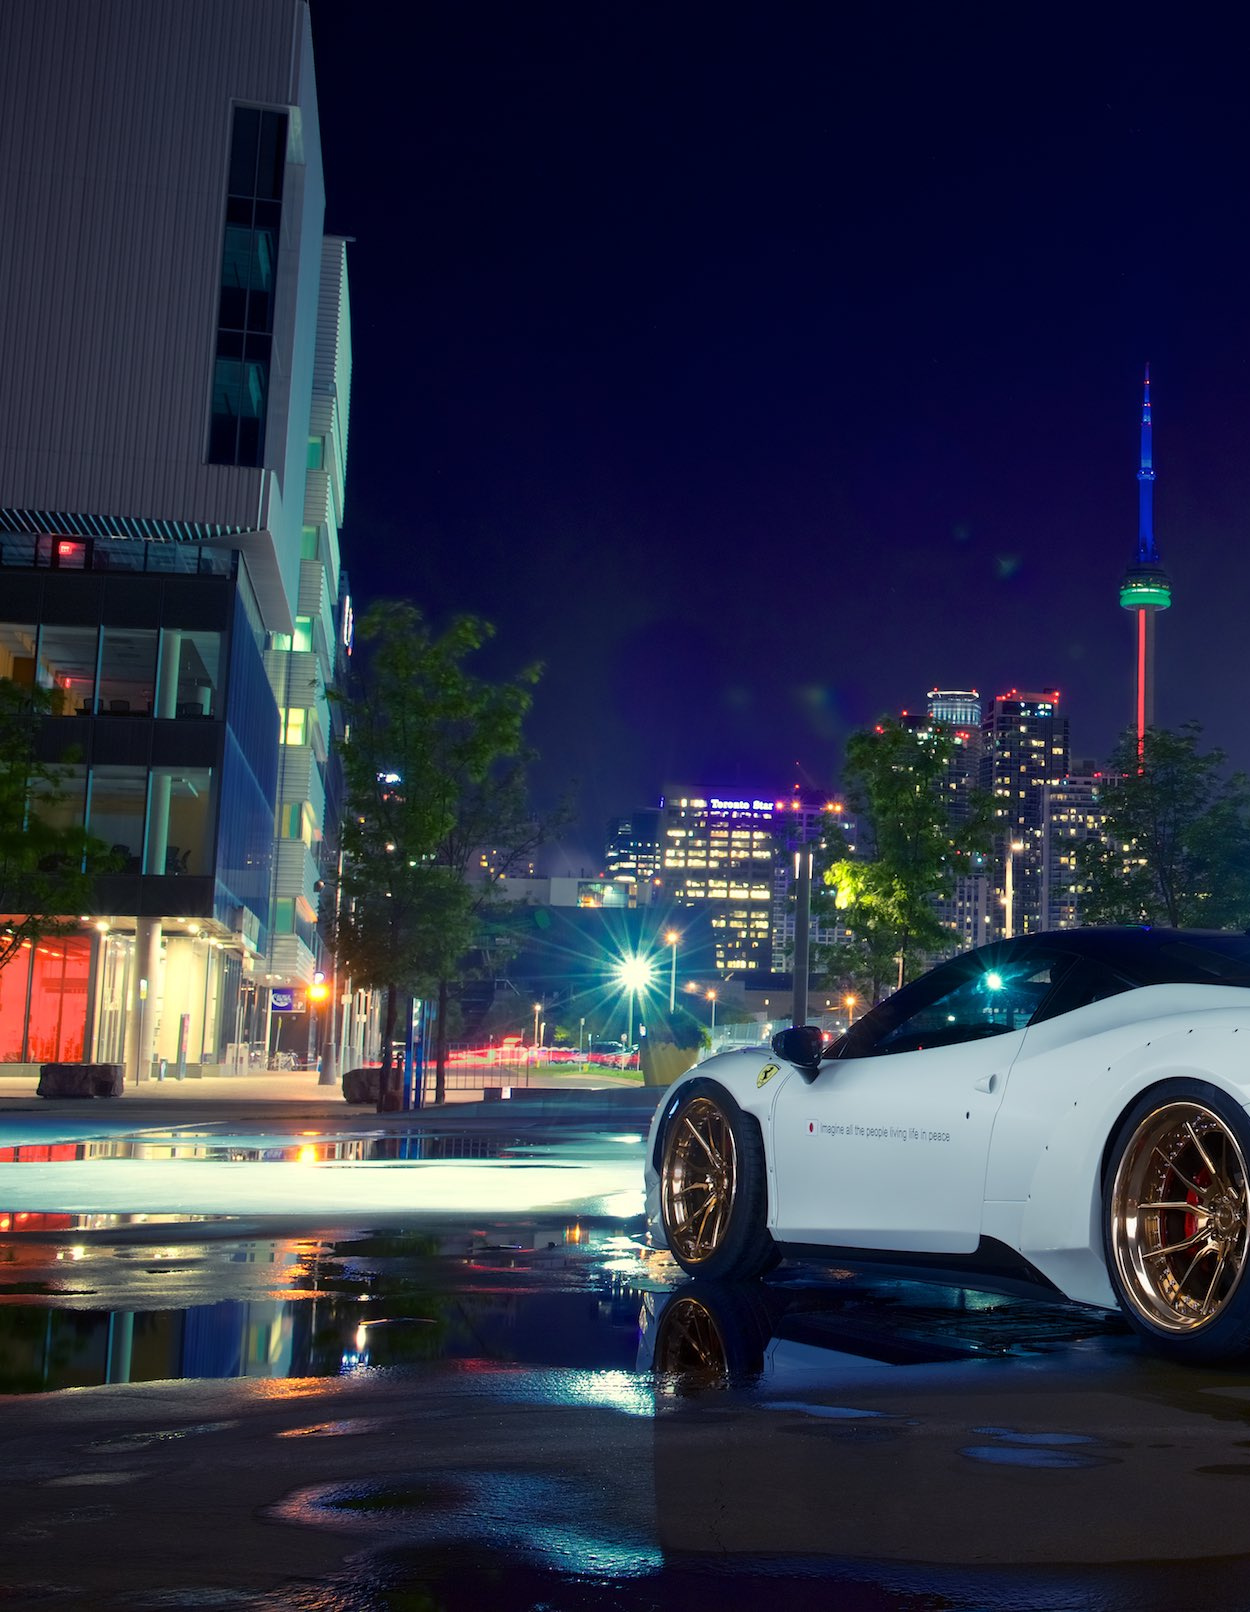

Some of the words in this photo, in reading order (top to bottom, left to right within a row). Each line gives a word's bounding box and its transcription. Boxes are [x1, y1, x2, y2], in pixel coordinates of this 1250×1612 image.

[711, 799, 750, 809] Toronto
[753, 800, 774, 811] Star
[846, 1124, 854, 1135] all
[854, 1125, 864, 1136] the
[866, 1127, 888, 1138] people
[889, 1126, 907, 1141] living
[908, 1128, 919, 1141] life
[920, 1128, 928, 1141] in
[928, 1131, 950, 1142] peace
